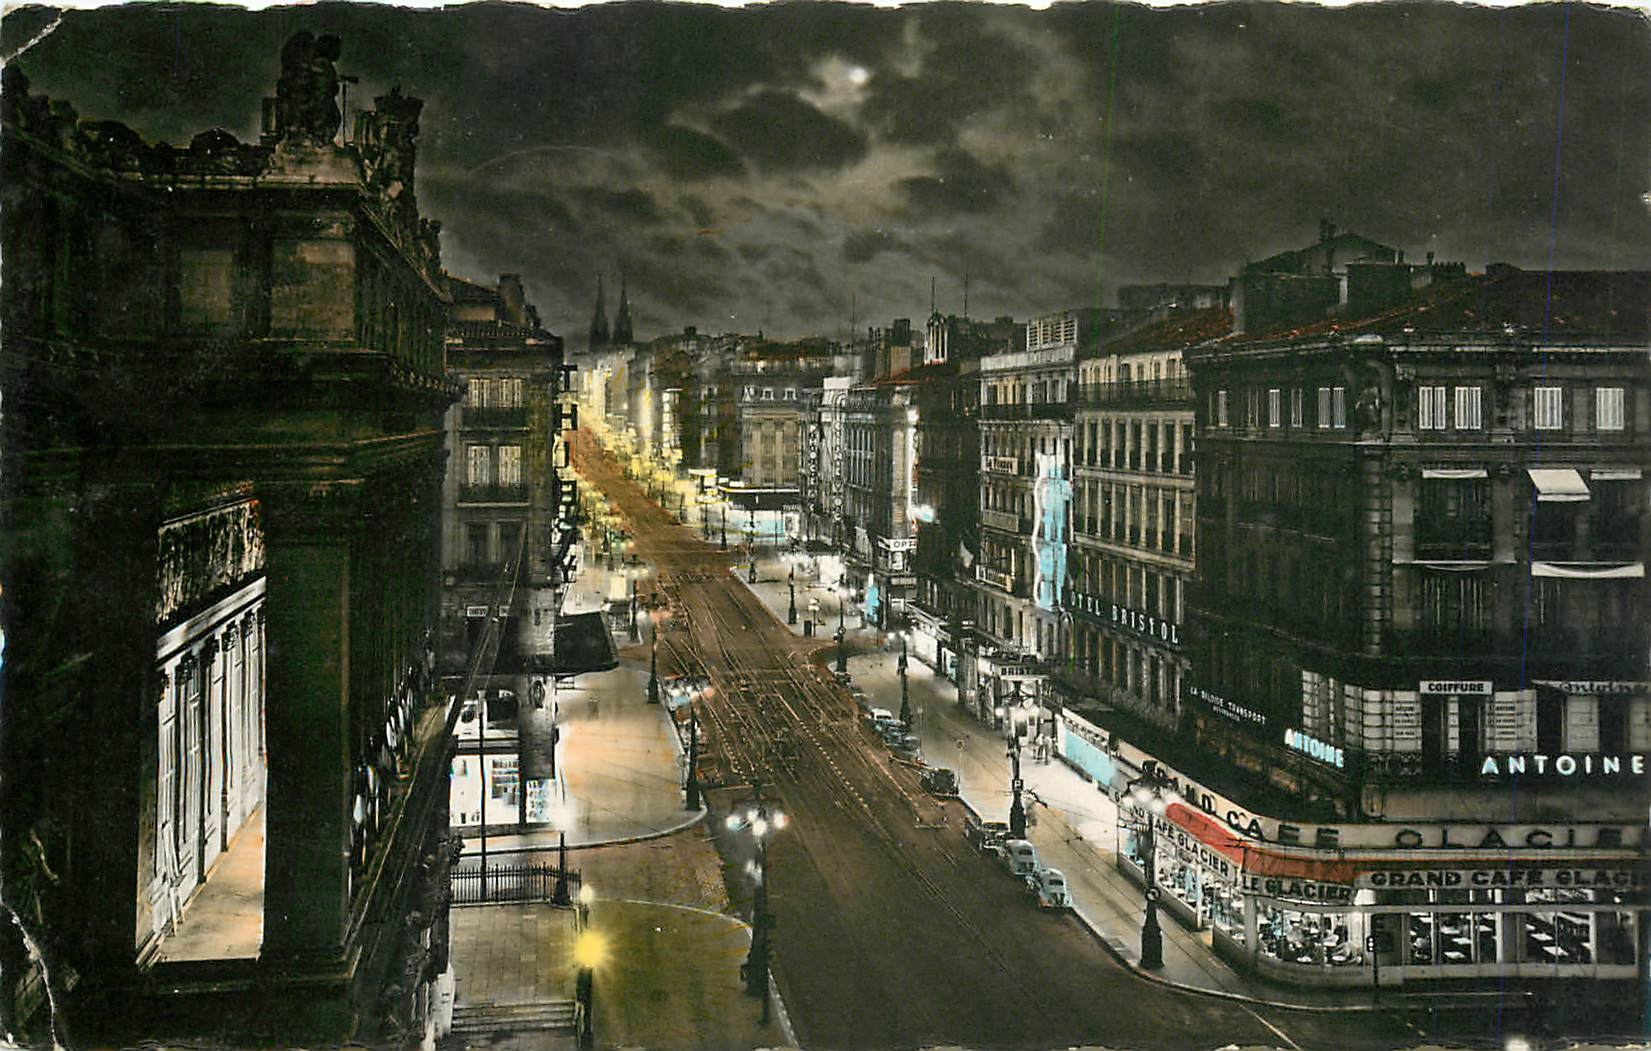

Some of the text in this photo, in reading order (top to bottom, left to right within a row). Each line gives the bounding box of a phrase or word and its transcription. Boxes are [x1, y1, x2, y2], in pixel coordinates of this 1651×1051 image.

[1071, 590, 1178, 644] OTEL BRISTOL
[1000, 667, 1031, 676] BRIST
[1428, 683, 1484, 692] COIFFURE
[1284, 728, 1344, 768] ANTOINE
[1481, 755, 1645, 775] ANTOINE
[1155, 817, 1174, 839] AFE
[1177, 834, 1229, 877] GLACIER
[1243, 875, 1351, 899] LE GLACIER
[1370, 870, 1462, 886] GRAND
